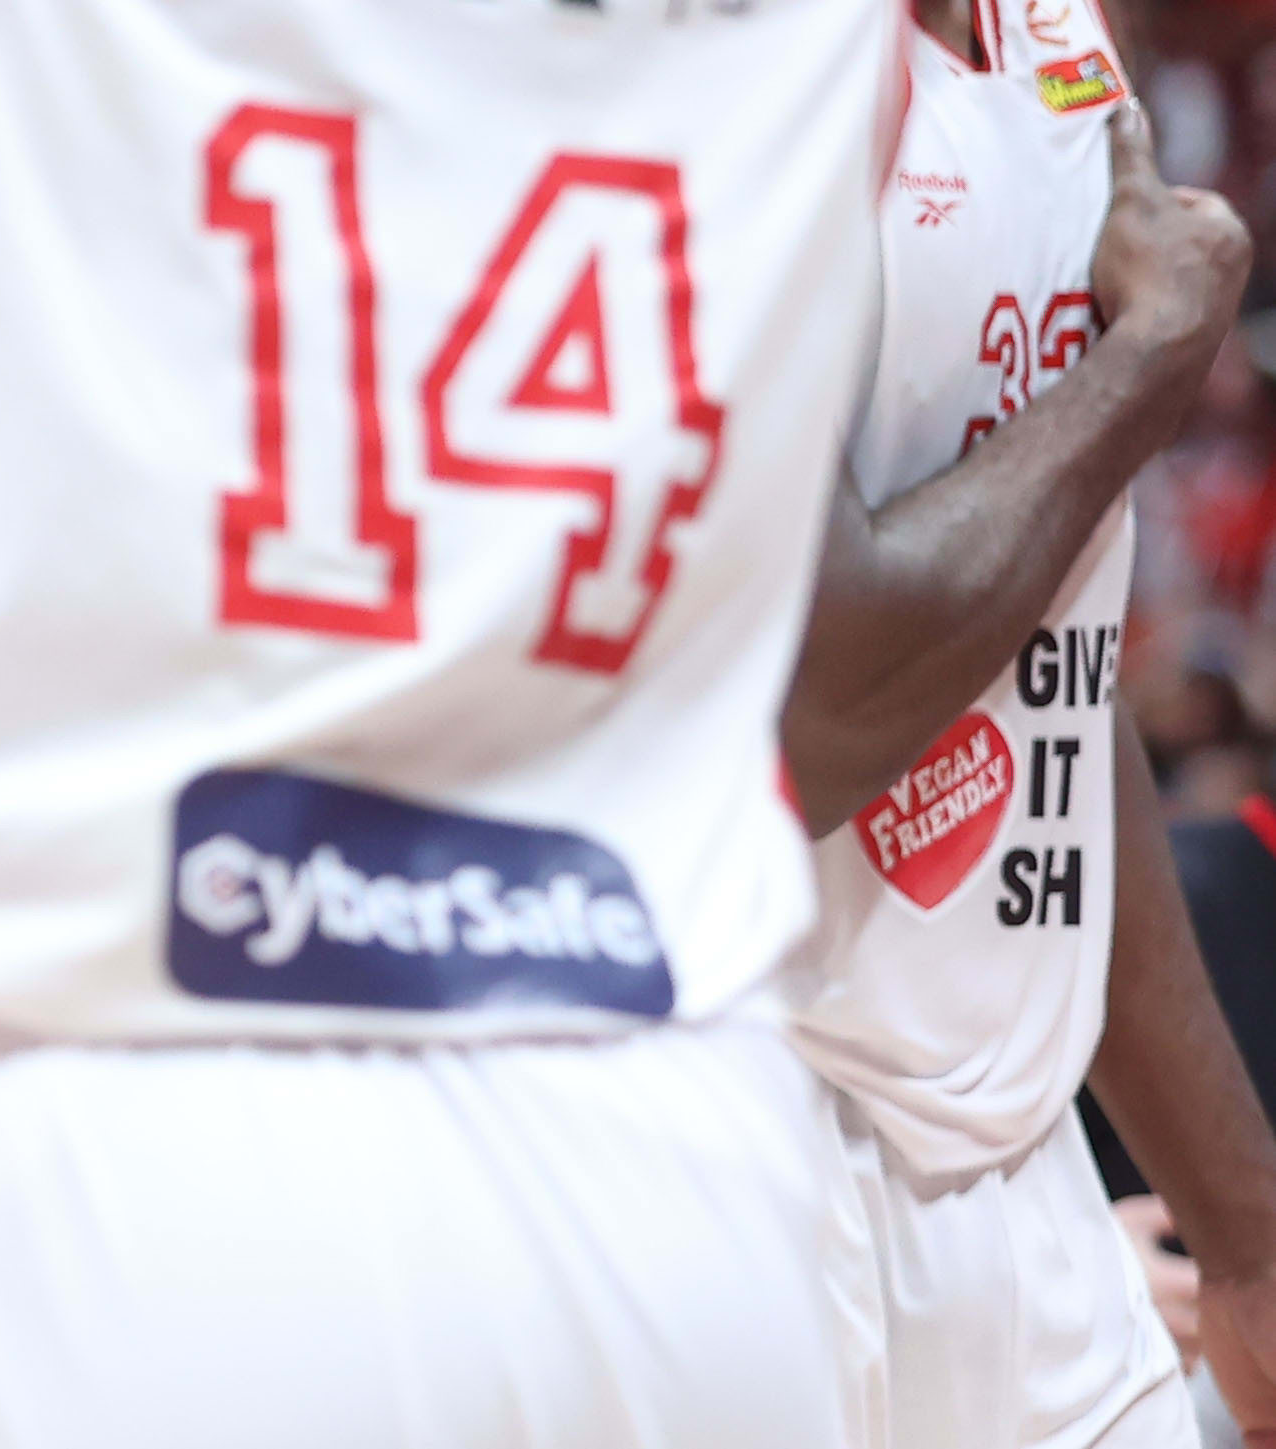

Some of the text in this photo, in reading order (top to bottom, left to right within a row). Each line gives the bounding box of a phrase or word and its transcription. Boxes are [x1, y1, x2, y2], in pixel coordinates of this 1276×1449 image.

[202, 101, 725, 676] 14
[867, 753, 1007, 872] FRIENDLY
[888, 726, 993, 816] VEGAN
[1027, 737, 1081, 819] IT
